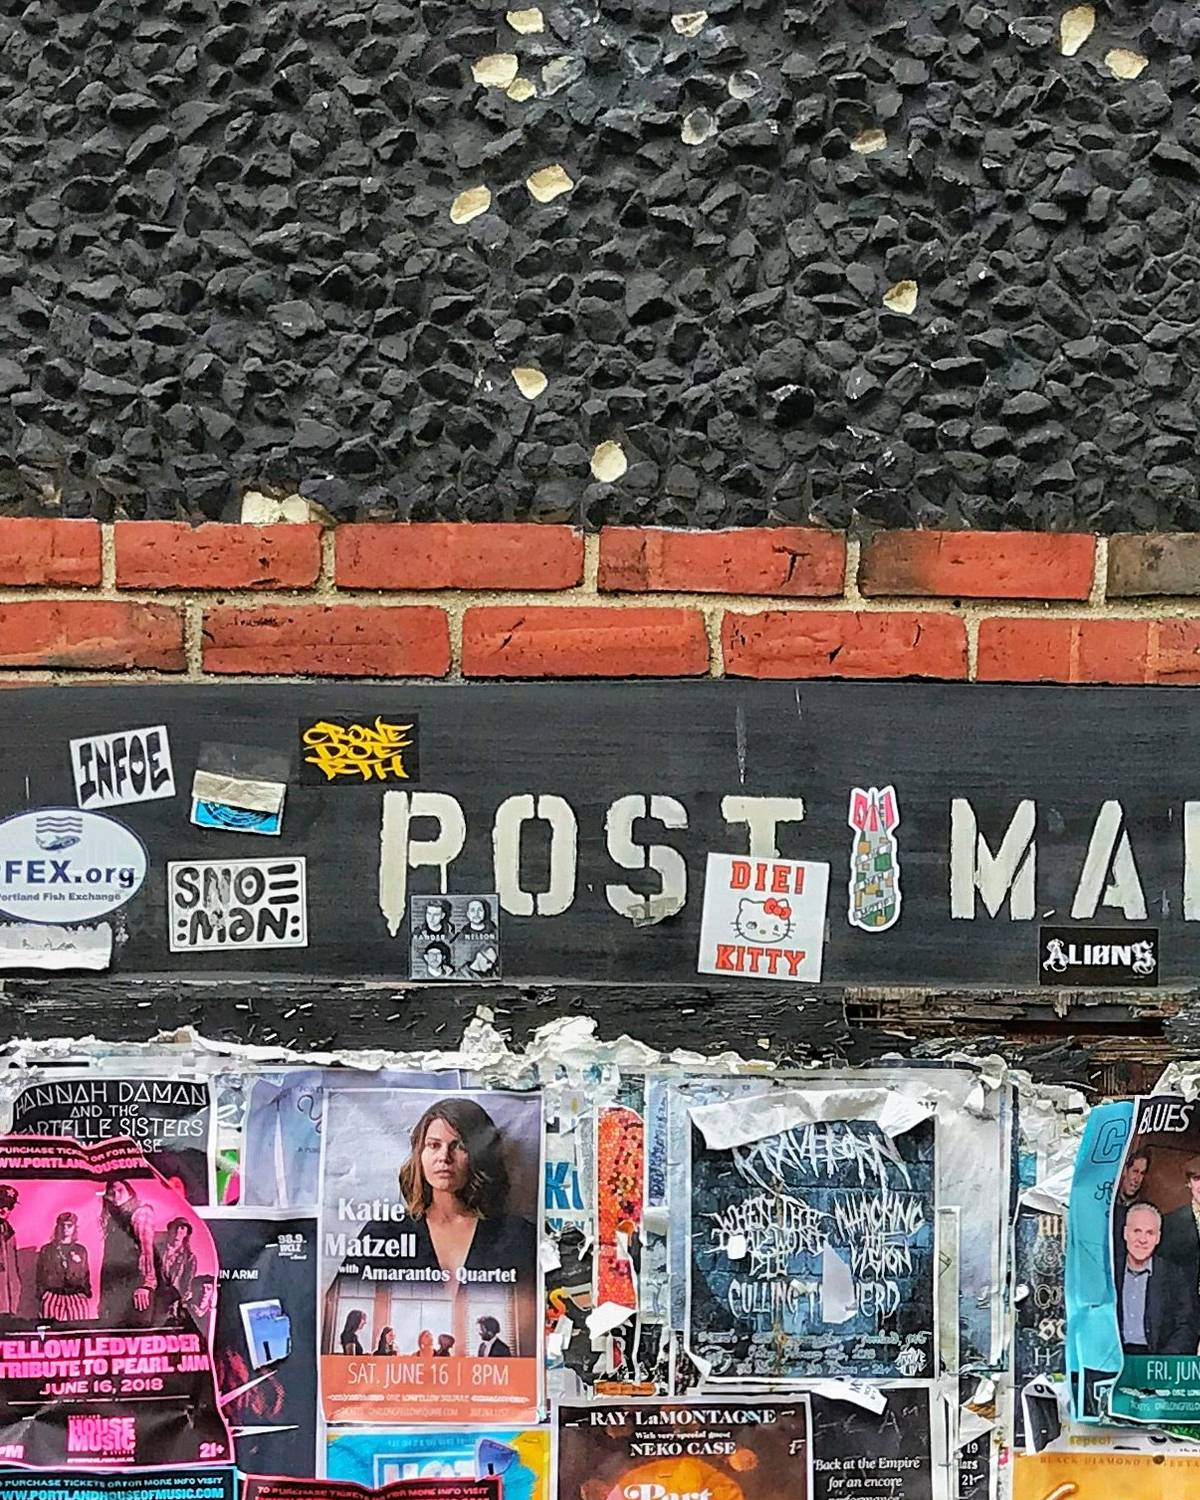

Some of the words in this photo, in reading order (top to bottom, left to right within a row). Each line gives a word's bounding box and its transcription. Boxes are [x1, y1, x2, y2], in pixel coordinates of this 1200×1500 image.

[730, 860, 805, 895] DIE!
[716, 945, 806, 977] KITTY
[16, 1082, 107, 1119] HANNAH
[119, 1082, 206, 1105] DAMAN
[1137, 1105, 1194, 1134] BLUES
[338, 1198, 405, 1222] Katie
[325, 1233, 416, 1257] Matzell
[84, 1334, 200, 1357] LEDVEDDER
[40, 1381, 88, 1395] JUNE
[94, 1380, 116, 1394] 16,
[121, 1379, 163, 1392] 2018
[590, 1411, 629, 1427] RAY
[636, 1409, 777, 1425] LaMONTAGNE
[631, 1442, 685, 1457] NEKO
[687, 1442, 736, 1456] CASE
[843, 1460, 855, 1469] at
[858, 1458, 875, 1469] the
[878, 1457, 920, 1470] Empire
[827, 1476, 843, 1491] for
[847, 1478, 861, 1488] an
[864, 1477, 902, 1488] encore
